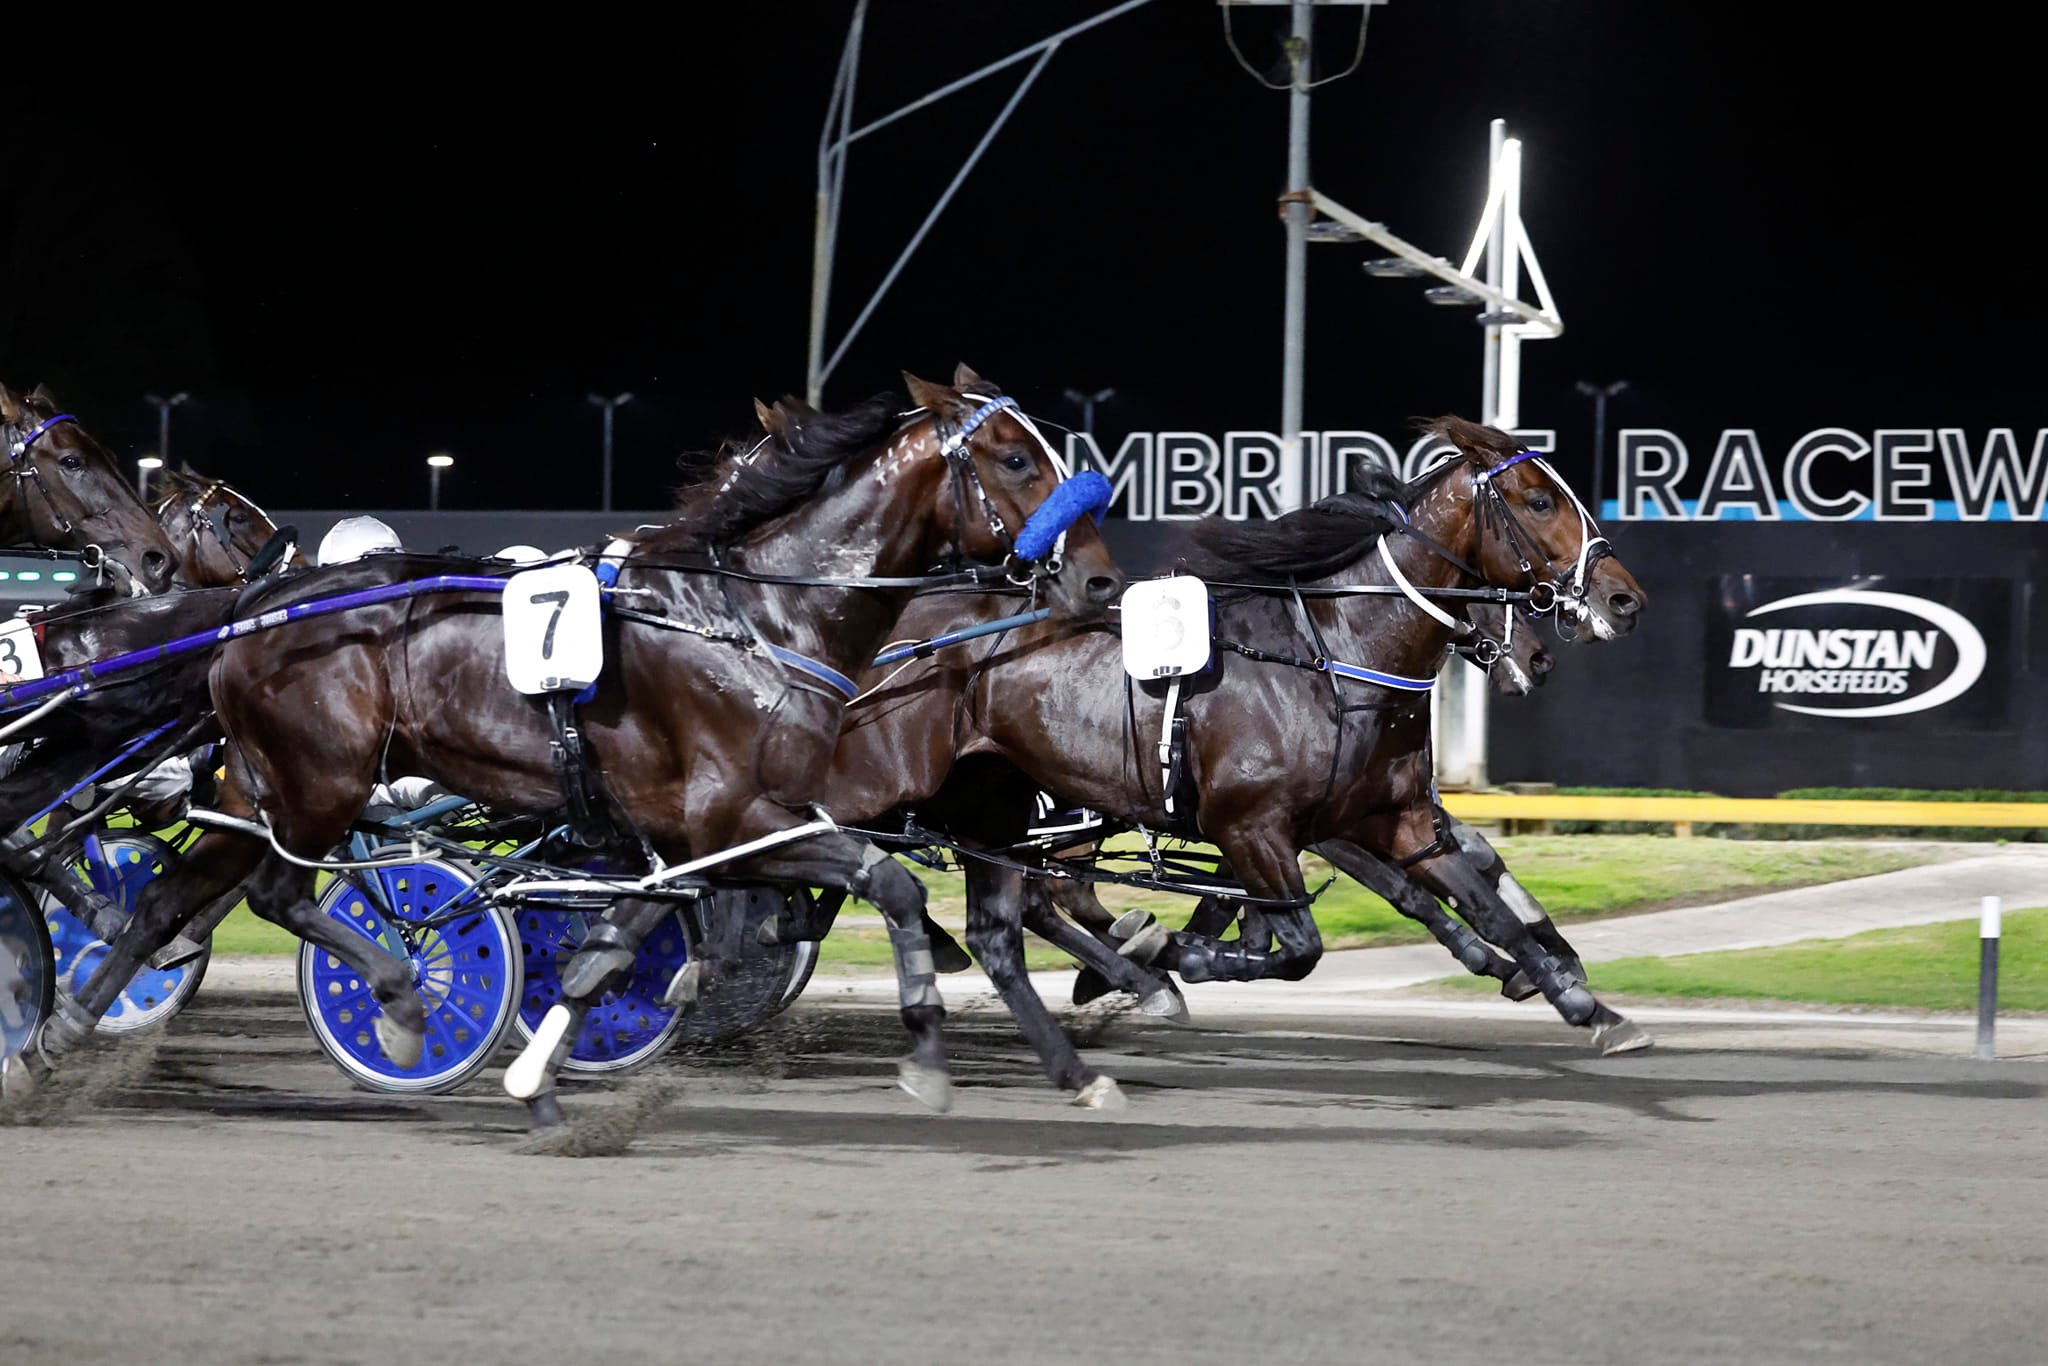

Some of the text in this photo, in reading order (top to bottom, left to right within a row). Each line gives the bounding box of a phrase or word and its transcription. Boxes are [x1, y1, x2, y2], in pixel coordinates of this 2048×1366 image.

[1066, 428, 2048, 522] MBRID RACEW
[530, 590, 570, 660] 7
[0, 637, 23, 675] 3
[1729, 628, 1939, 670] DUNSTAN
[1758, 669, 1909, 694] HORSEFEEDS
